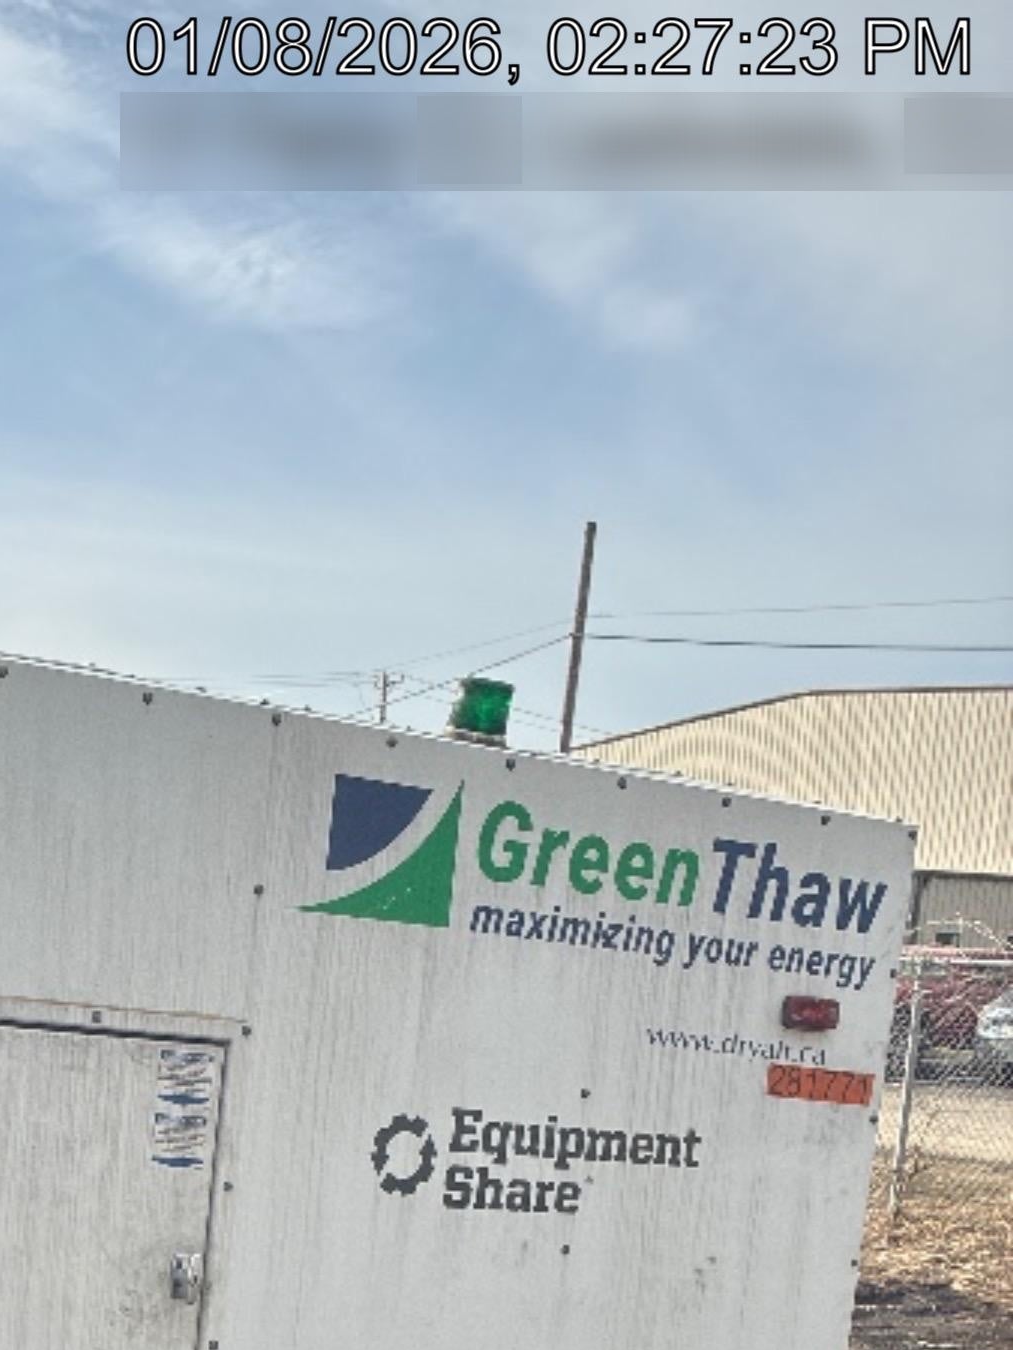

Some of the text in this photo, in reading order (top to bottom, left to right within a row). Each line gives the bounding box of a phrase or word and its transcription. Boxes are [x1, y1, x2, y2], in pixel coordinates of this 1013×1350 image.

[469, 904, 876, 991] maximizing your energy
[449, 1107, 702, 1170] Equipment
[443, 1164, 582, 1214] Share
